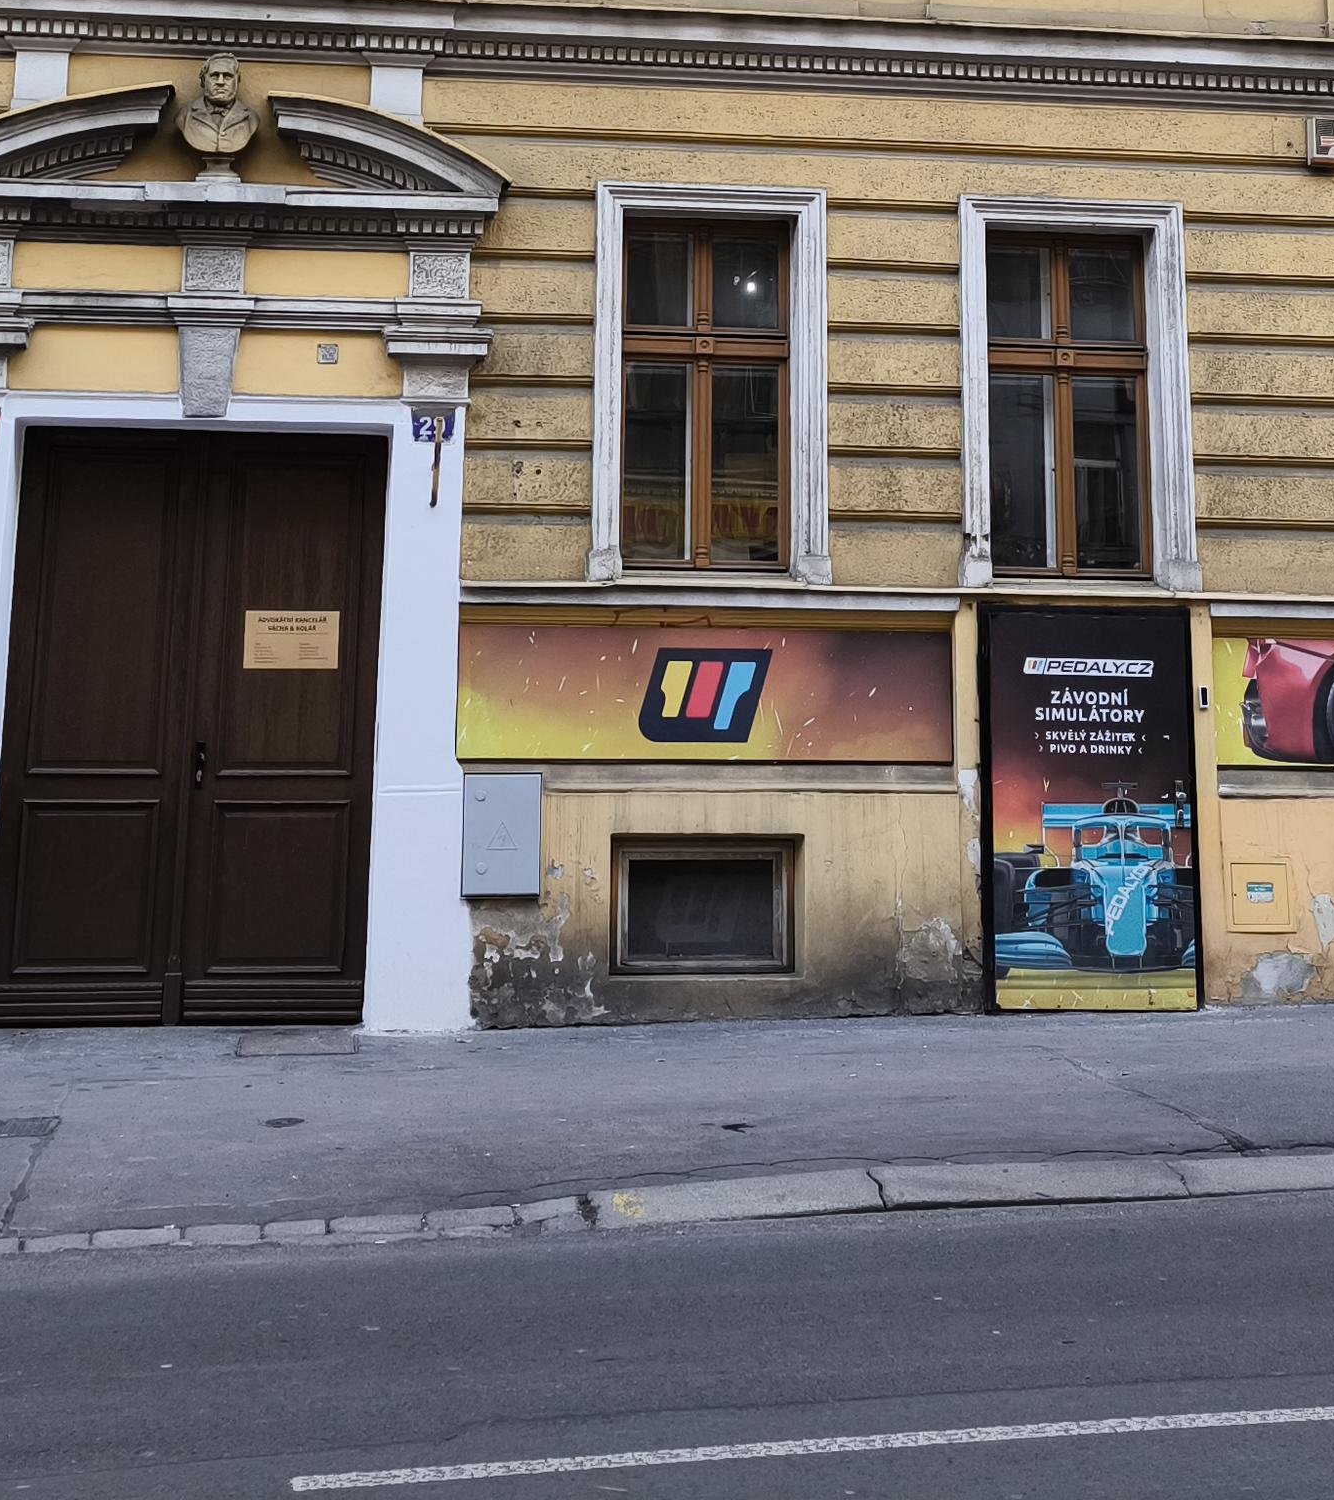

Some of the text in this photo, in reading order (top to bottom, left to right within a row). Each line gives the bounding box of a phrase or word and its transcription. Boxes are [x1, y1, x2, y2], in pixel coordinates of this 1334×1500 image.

[1046, 661, 1152, 675] PEDALY.CZ
[1050, 687, 1128, 706] ZÁVODNÍ
[1035, 705, 1145, 723] SIMULÁTORY
[1045, 729, 1136, 742] SKVĚLÝ ZÁŽITEK
[1050, 744, 1132, 755] PIVO A DRINKY
